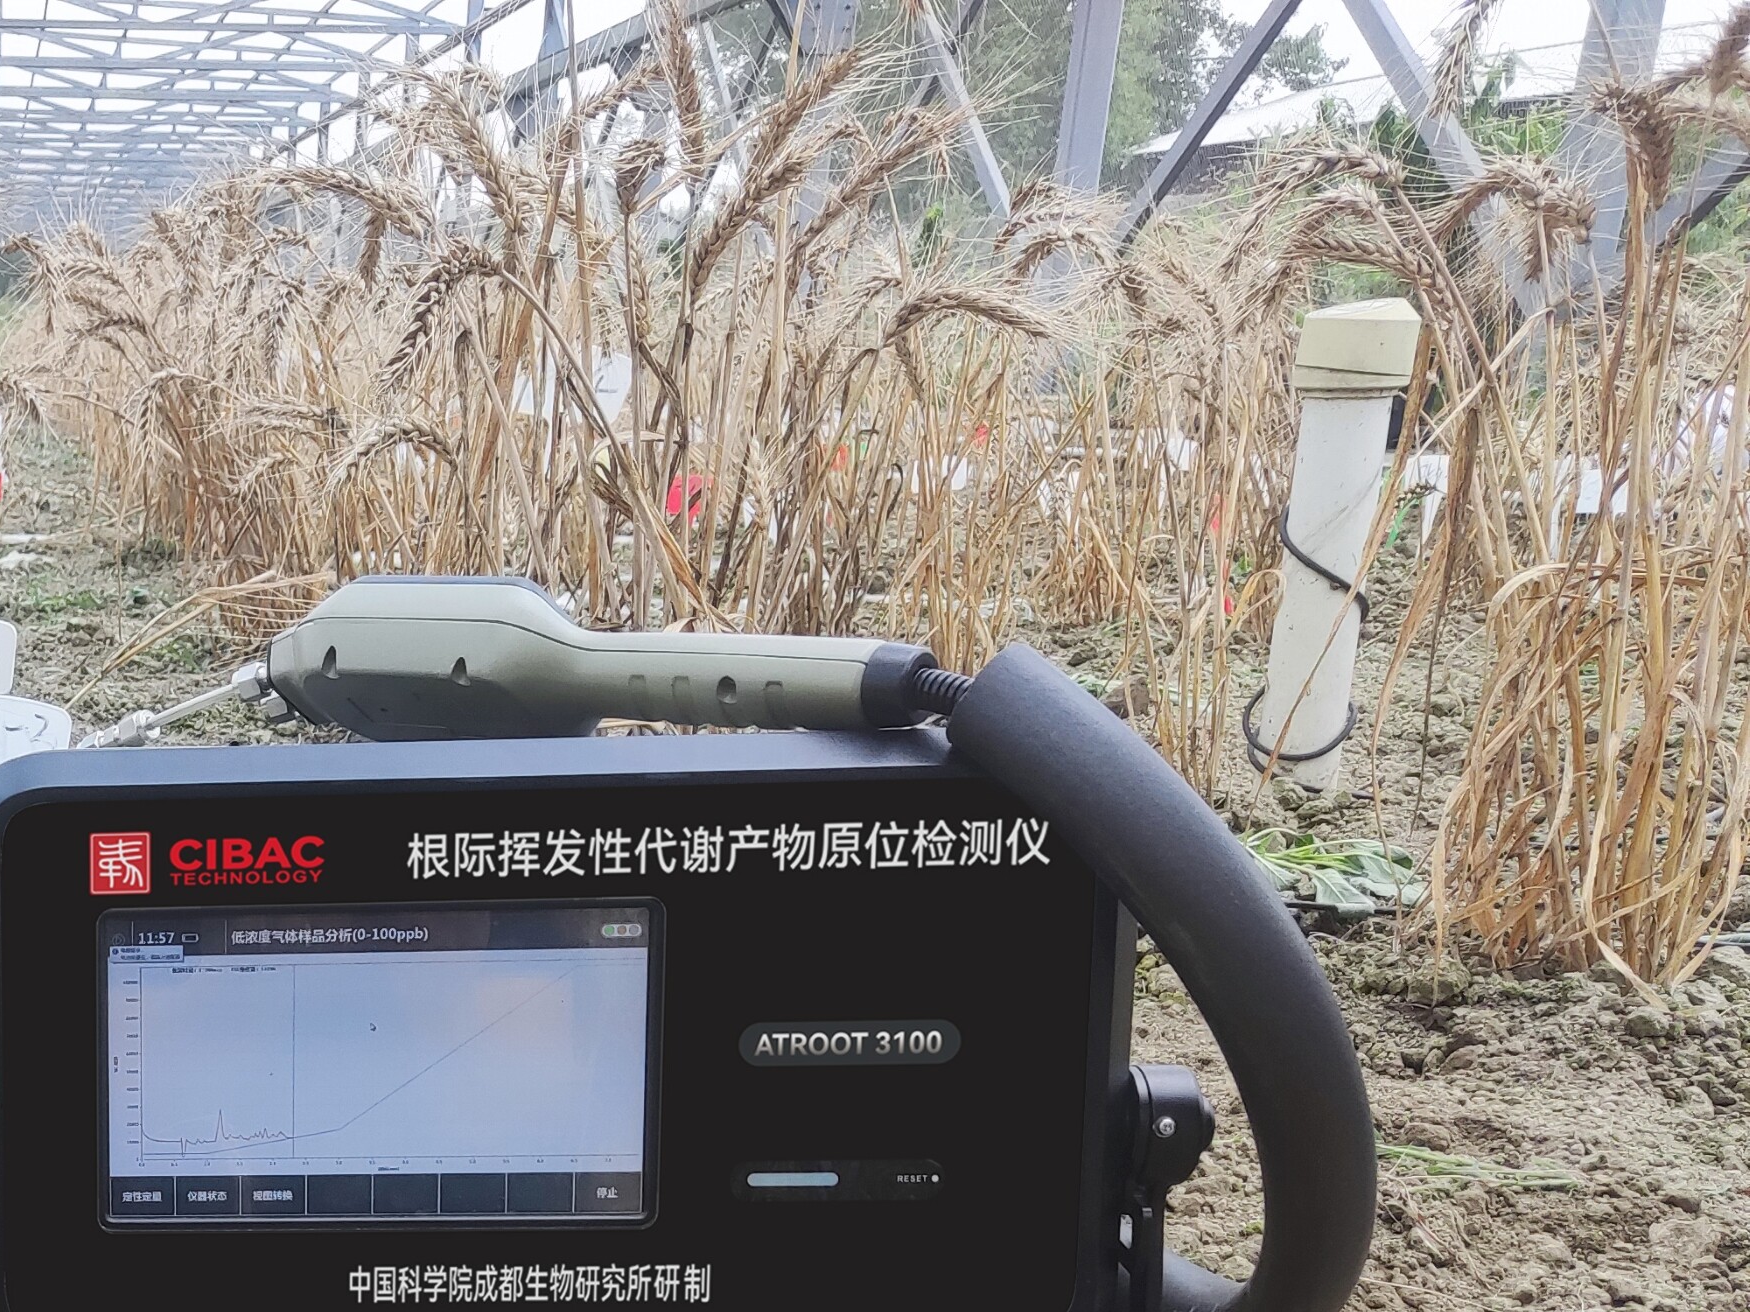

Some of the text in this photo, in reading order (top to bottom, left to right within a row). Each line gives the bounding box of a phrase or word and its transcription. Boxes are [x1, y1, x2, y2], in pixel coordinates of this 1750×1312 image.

[169, 835, 326, 871] CIBAC
[406, 817, 1051, 880] 根际挥发性代谢产物原位检测仪
[169, 868, 324, 887] TECHNOLOGY
[137, 932, 175, 945] 11:57
[753, 1030, 943, 1057] ATROOT 3100
[896, 1174, 929, 1183] RESET
[348, 1263, 712, 1303] 中国科学院成都生物研究所研制
